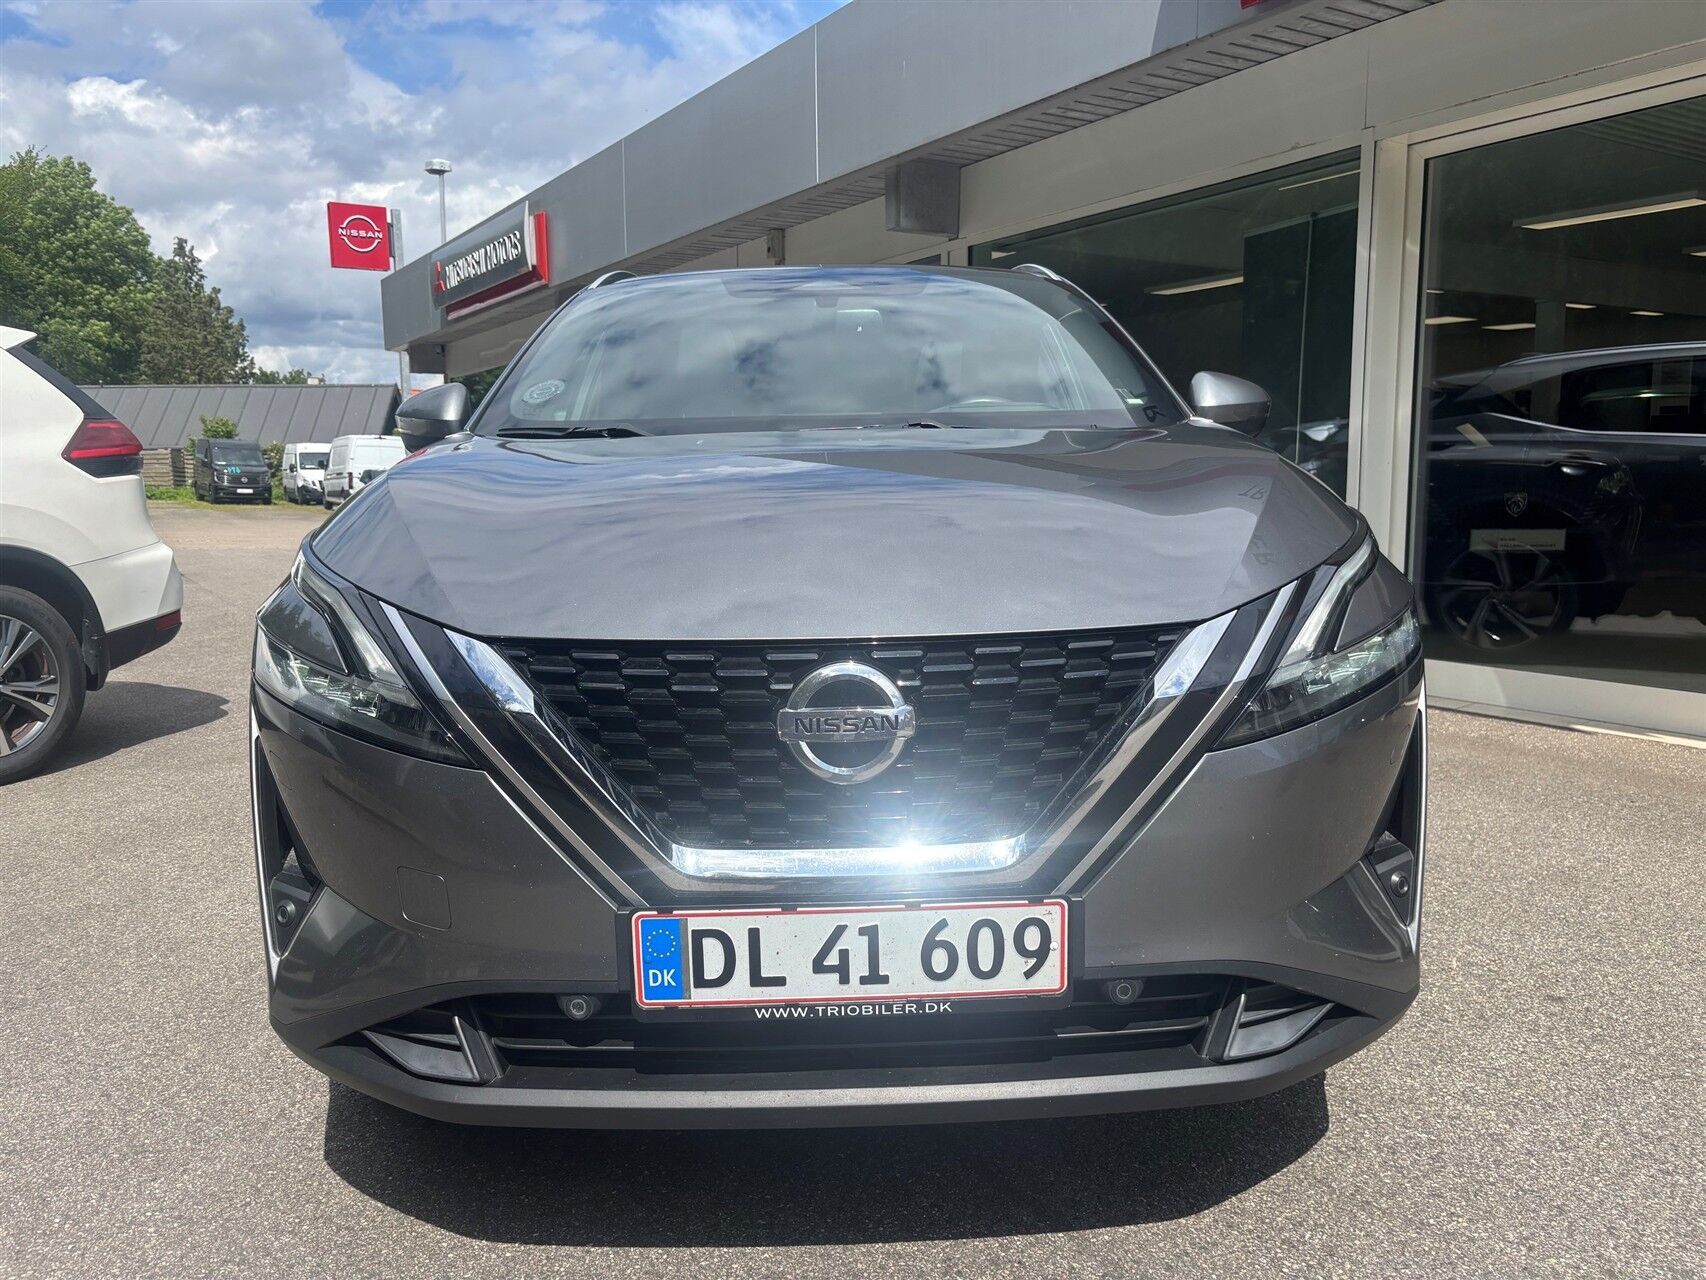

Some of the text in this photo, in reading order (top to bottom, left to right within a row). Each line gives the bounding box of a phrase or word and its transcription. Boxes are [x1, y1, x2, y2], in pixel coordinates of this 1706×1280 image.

[338, 228, 383, 239] NISSAN
[794, 714, 899, 734] NISSAN
[691, 917, 1051, 989] DL 41 609
[647, 968, 677, 986] DK
[754, 1002, 953, 1019] WWW.TRIOBILER.DK
